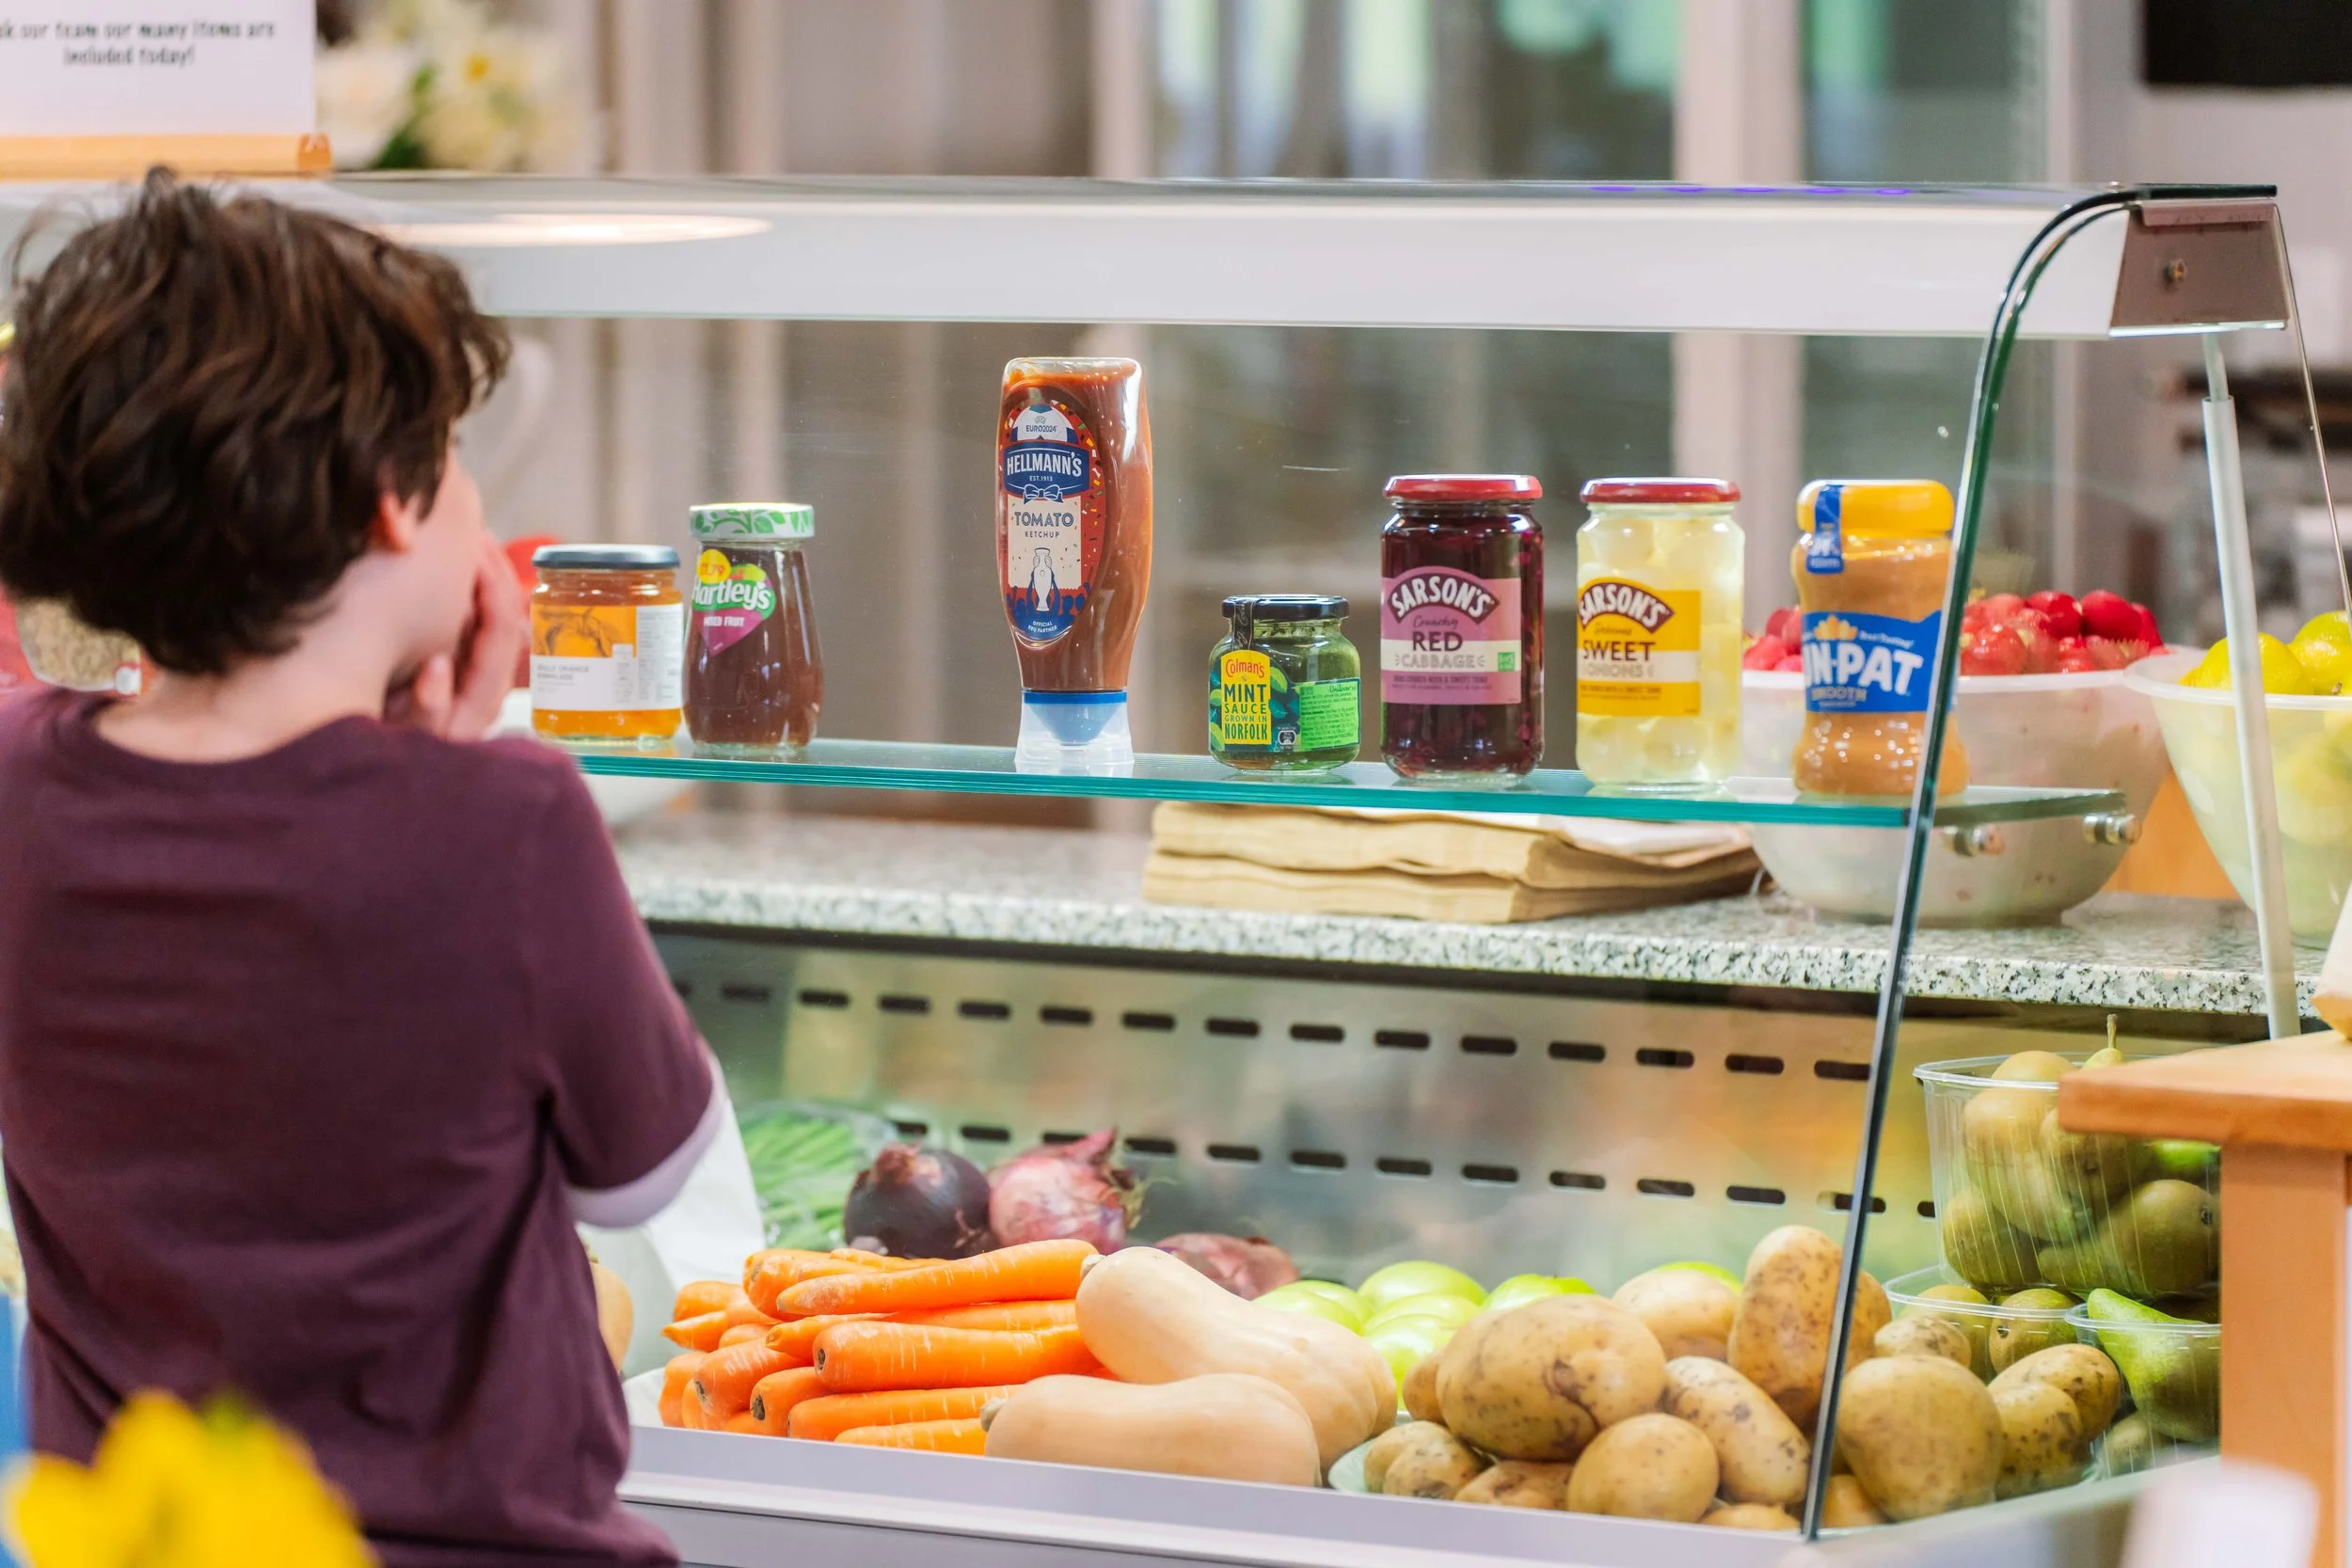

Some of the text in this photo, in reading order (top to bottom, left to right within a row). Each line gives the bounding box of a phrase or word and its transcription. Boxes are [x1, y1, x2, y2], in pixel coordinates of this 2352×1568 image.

[22, 24, 47, 38] our
[56, 22, 97, 38] team
[138, 24, 186, 40] many
[192, 20, 241, 38] items
[246, 23, 275, 38] are
[63, 44, 133, 65] included
[1025, 424, 1057, 433] EURO2024
[1007, 451, 1082, 477] HELLMANN'S
[1014, 512, 1074, 528] TOMATO
[1025, 531, 1059, 539] KETCHUP
[1391, 576, 1491, 618] SARSON'S
[1413, 631, 1464, 652] RED
[1583, 640, 1656, 661] SWEET
[1225, 658, 1265, 678] Colman's
[1401, 654, 1476, 669] CABBAGE
[1224, 684, 1267, 703] MINT
[1224, 703, 1267, 714] SAUCE
[1224, 723, 1267, 739] NORFOLK
